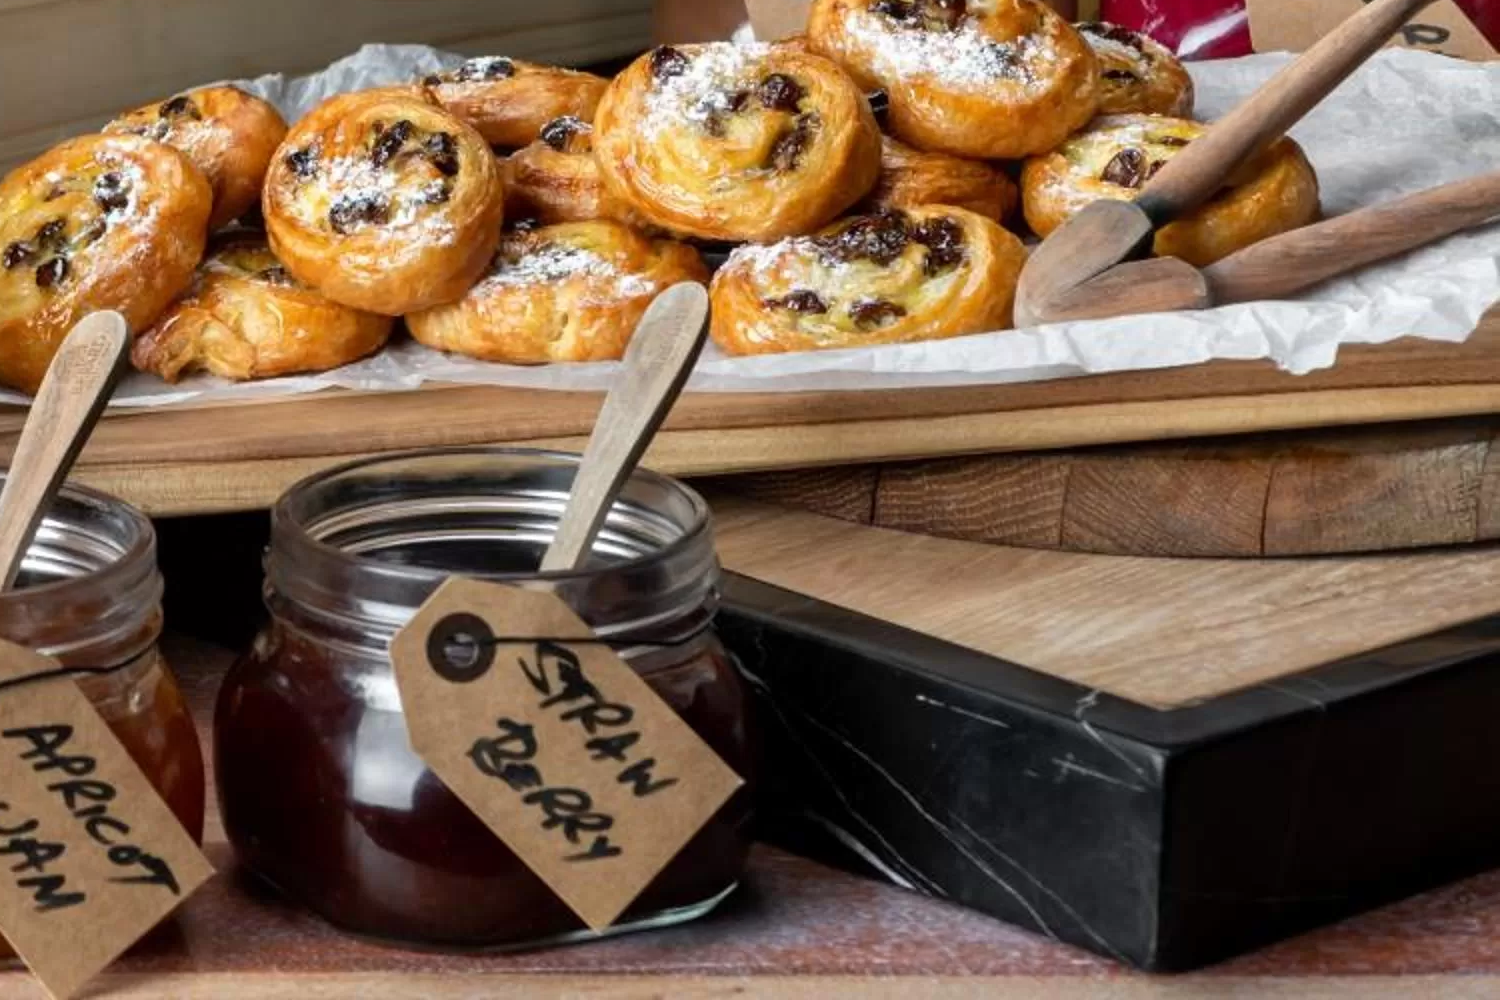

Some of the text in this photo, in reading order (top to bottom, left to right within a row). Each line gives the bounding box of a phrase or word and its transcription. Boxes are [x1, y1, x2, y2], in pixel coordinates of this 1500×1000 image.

[466, 717, 623, 863] BERRY
[518, 642, 679, 798] STRAW
[1, 723, 181, 896] APRICOT
